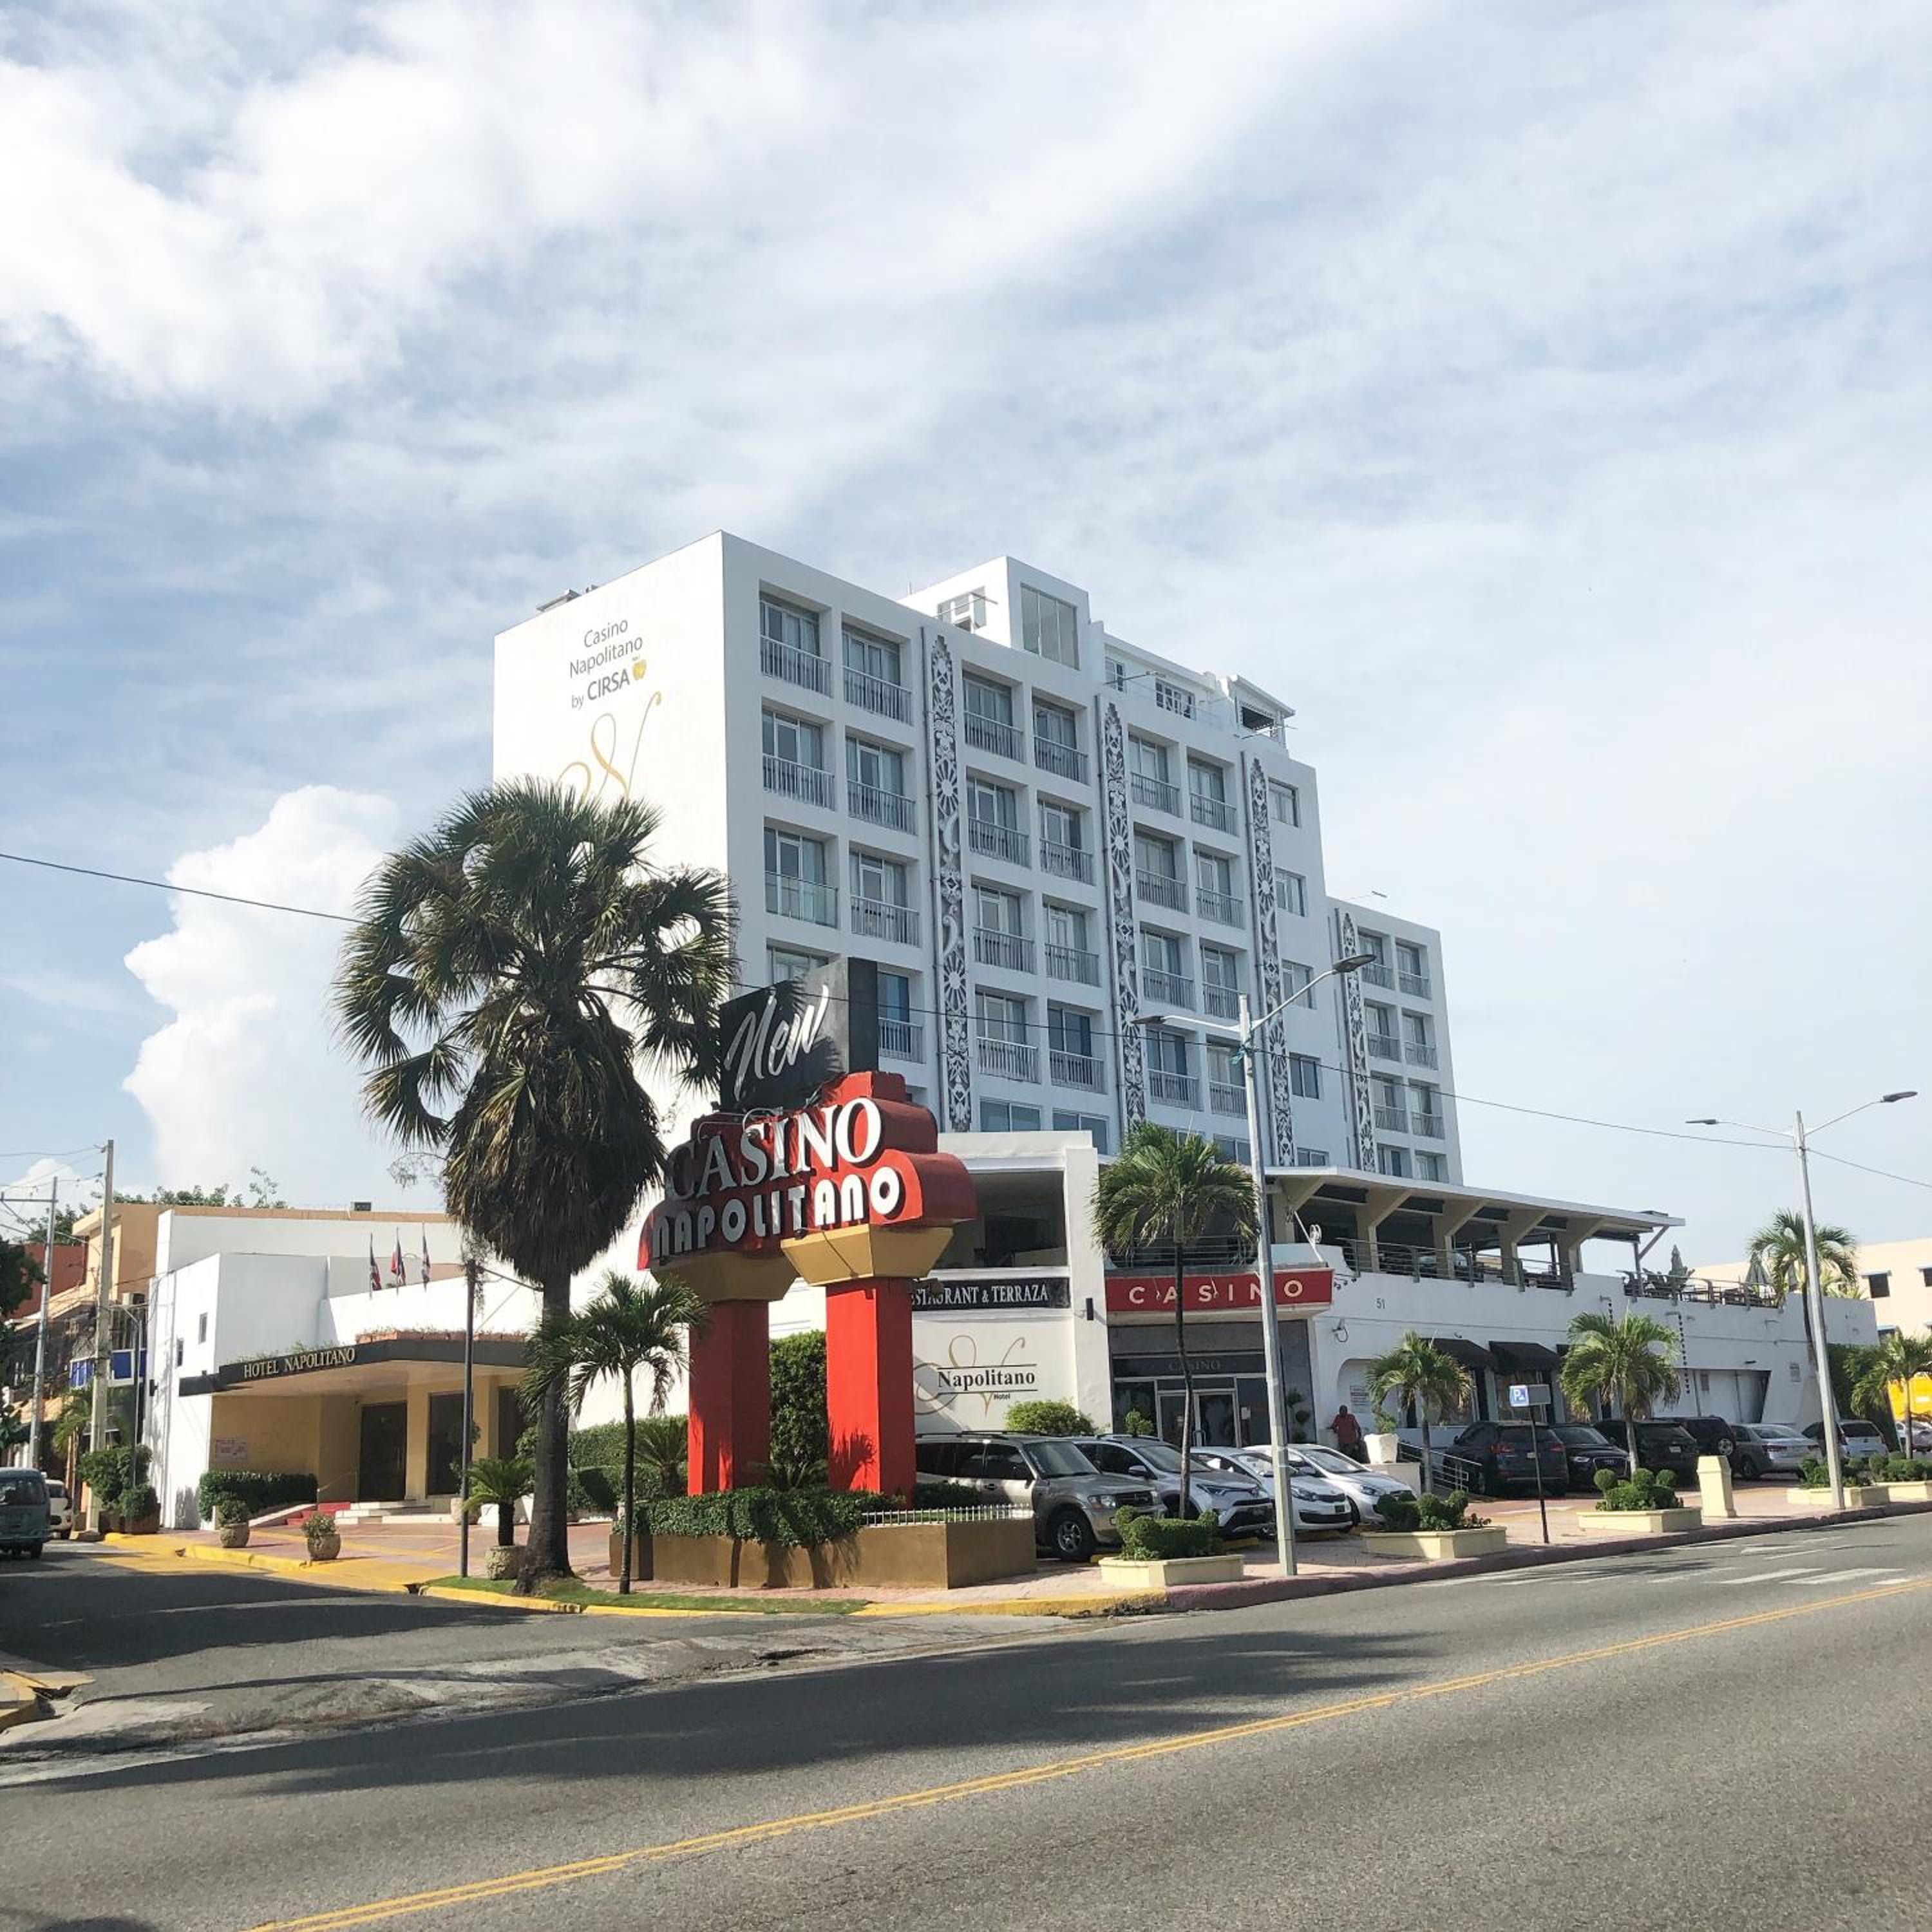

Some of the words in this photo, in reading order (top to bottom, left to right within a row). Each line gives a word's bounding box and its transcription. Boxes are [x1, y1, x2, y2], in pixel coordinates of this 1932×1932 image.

[584, 620, 628, 647] Casino
[570, 637, 643, 678] Napolitano
[571, 695, 584, 709] by
[587, 669, 630, 701] CIRSA
[666, 1097, 882, 1202] CASINO
[652, 1166, 900, 1258] NAPOLITANO
[982, 1291, 989, 1303] &
[992, 1283, 1049, 1302] TERRAZA
[1376, 1298, 1385, 1309] 51
[244, 1359, 279, 1378] HOTEL
[284, 1347, 355, 1372] NAPOLITANO
[938, 1369, 1035, 1391] Napolitano
